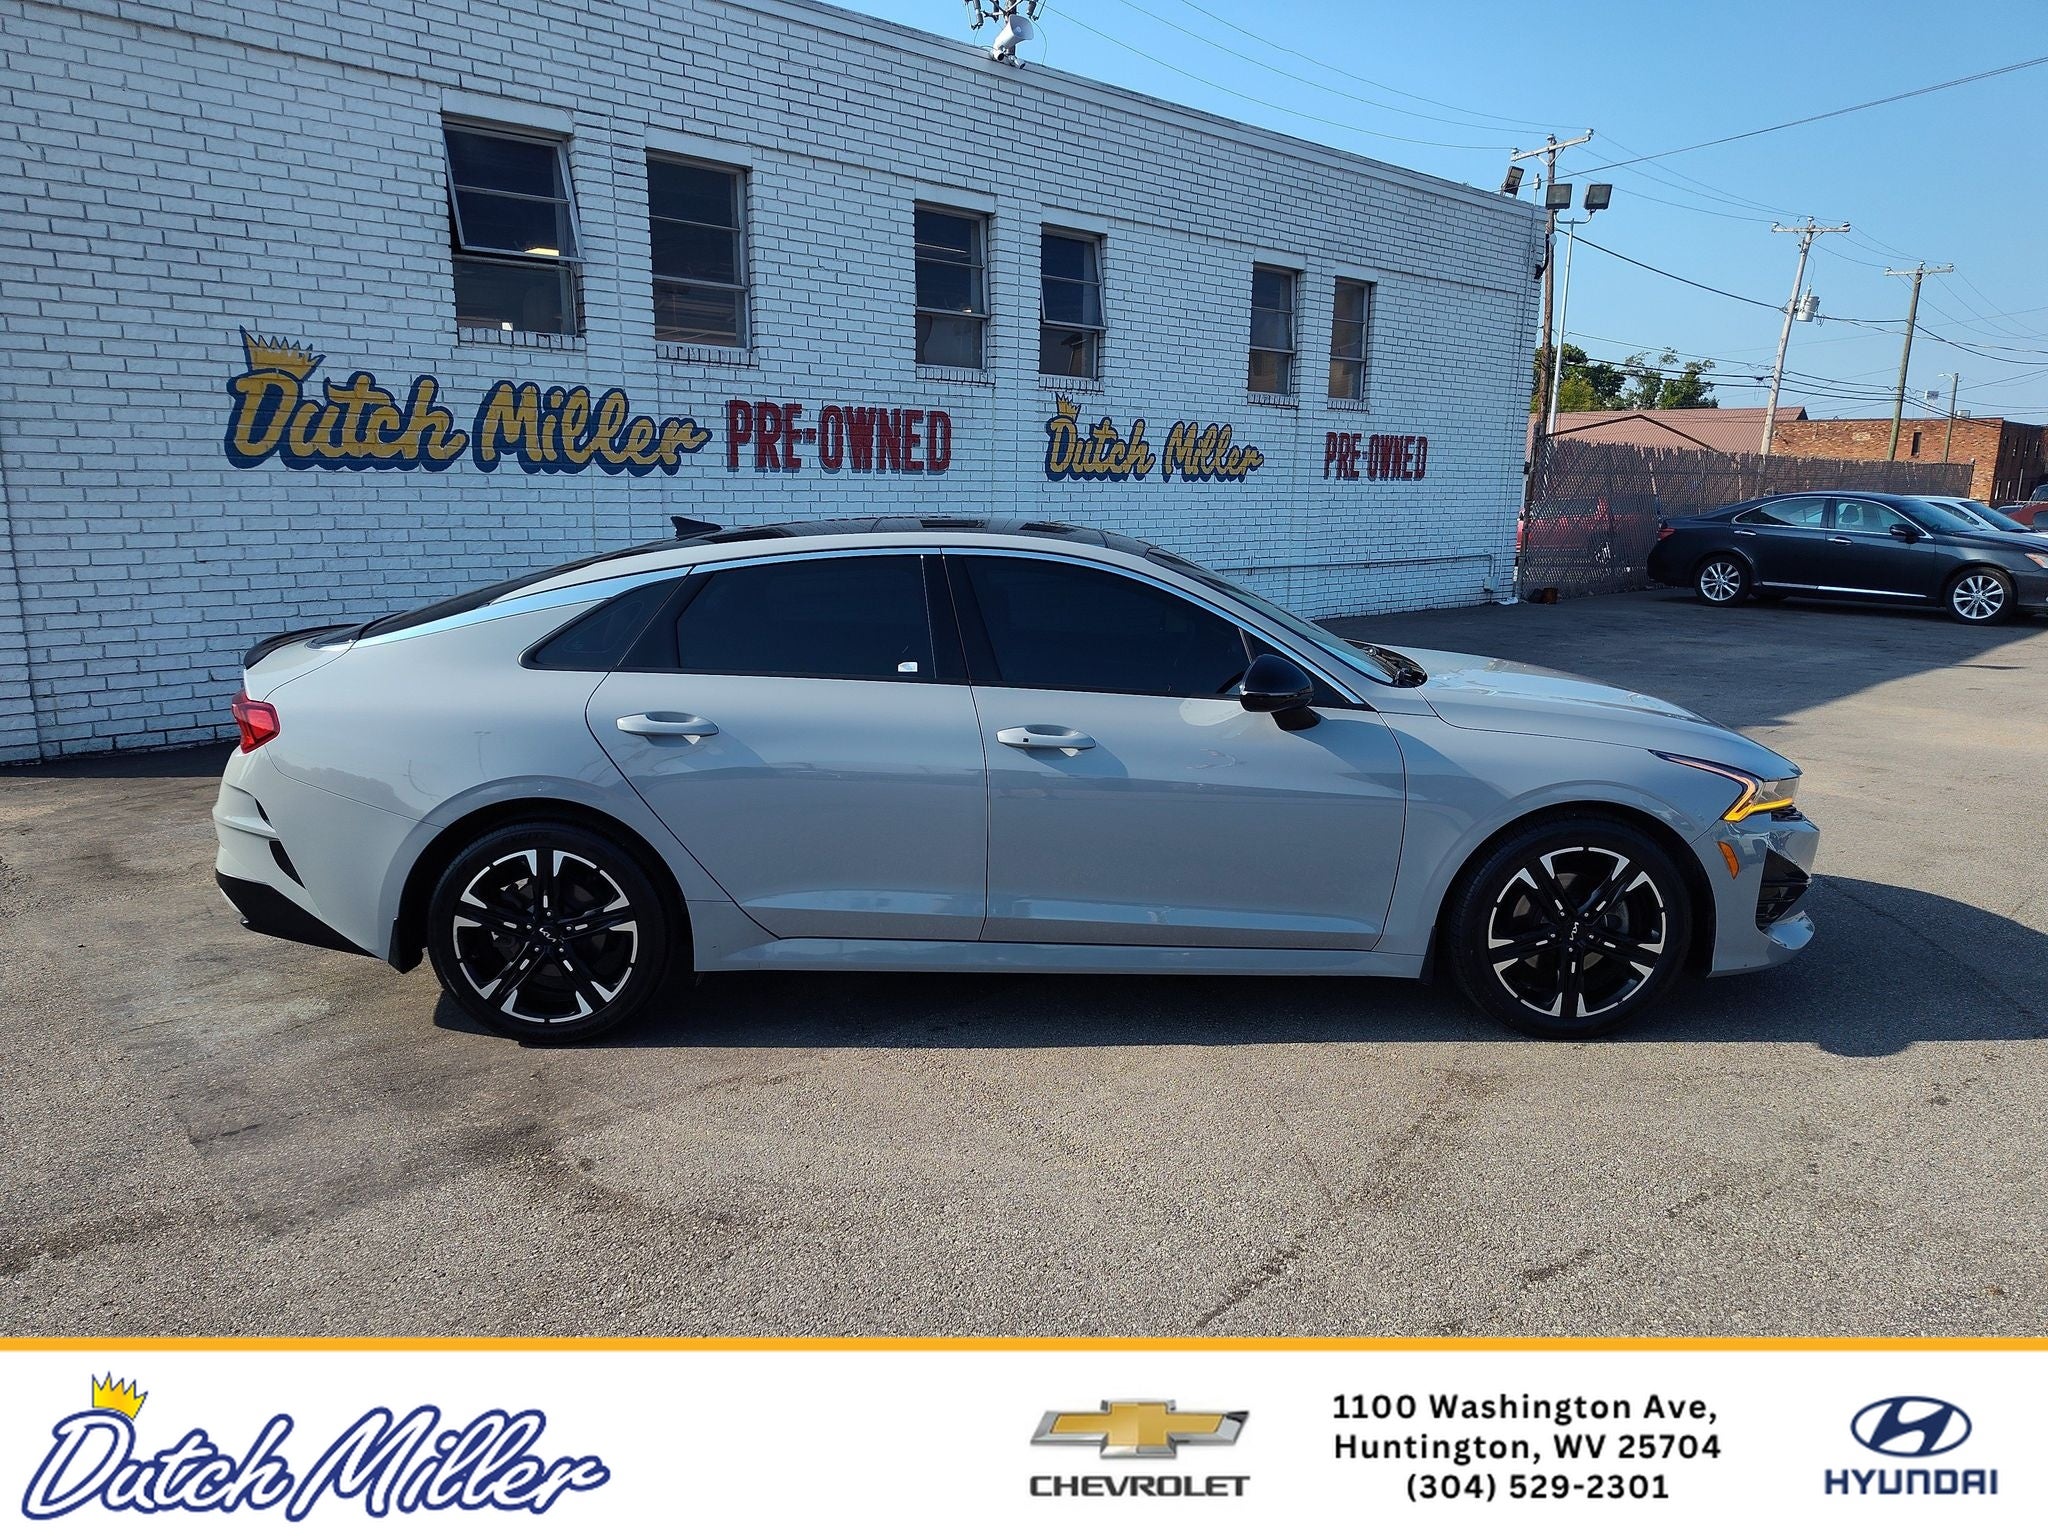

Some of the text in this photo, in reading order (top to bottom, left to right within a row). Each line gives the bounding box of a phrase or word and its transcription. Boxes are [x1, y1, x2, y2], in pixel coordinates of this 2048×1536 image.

[226, 370, 954, 478] Dutch Miller PRE-OWNED
[1044, 414, 1429, 483] Dutch Miller PRE-OWNED
